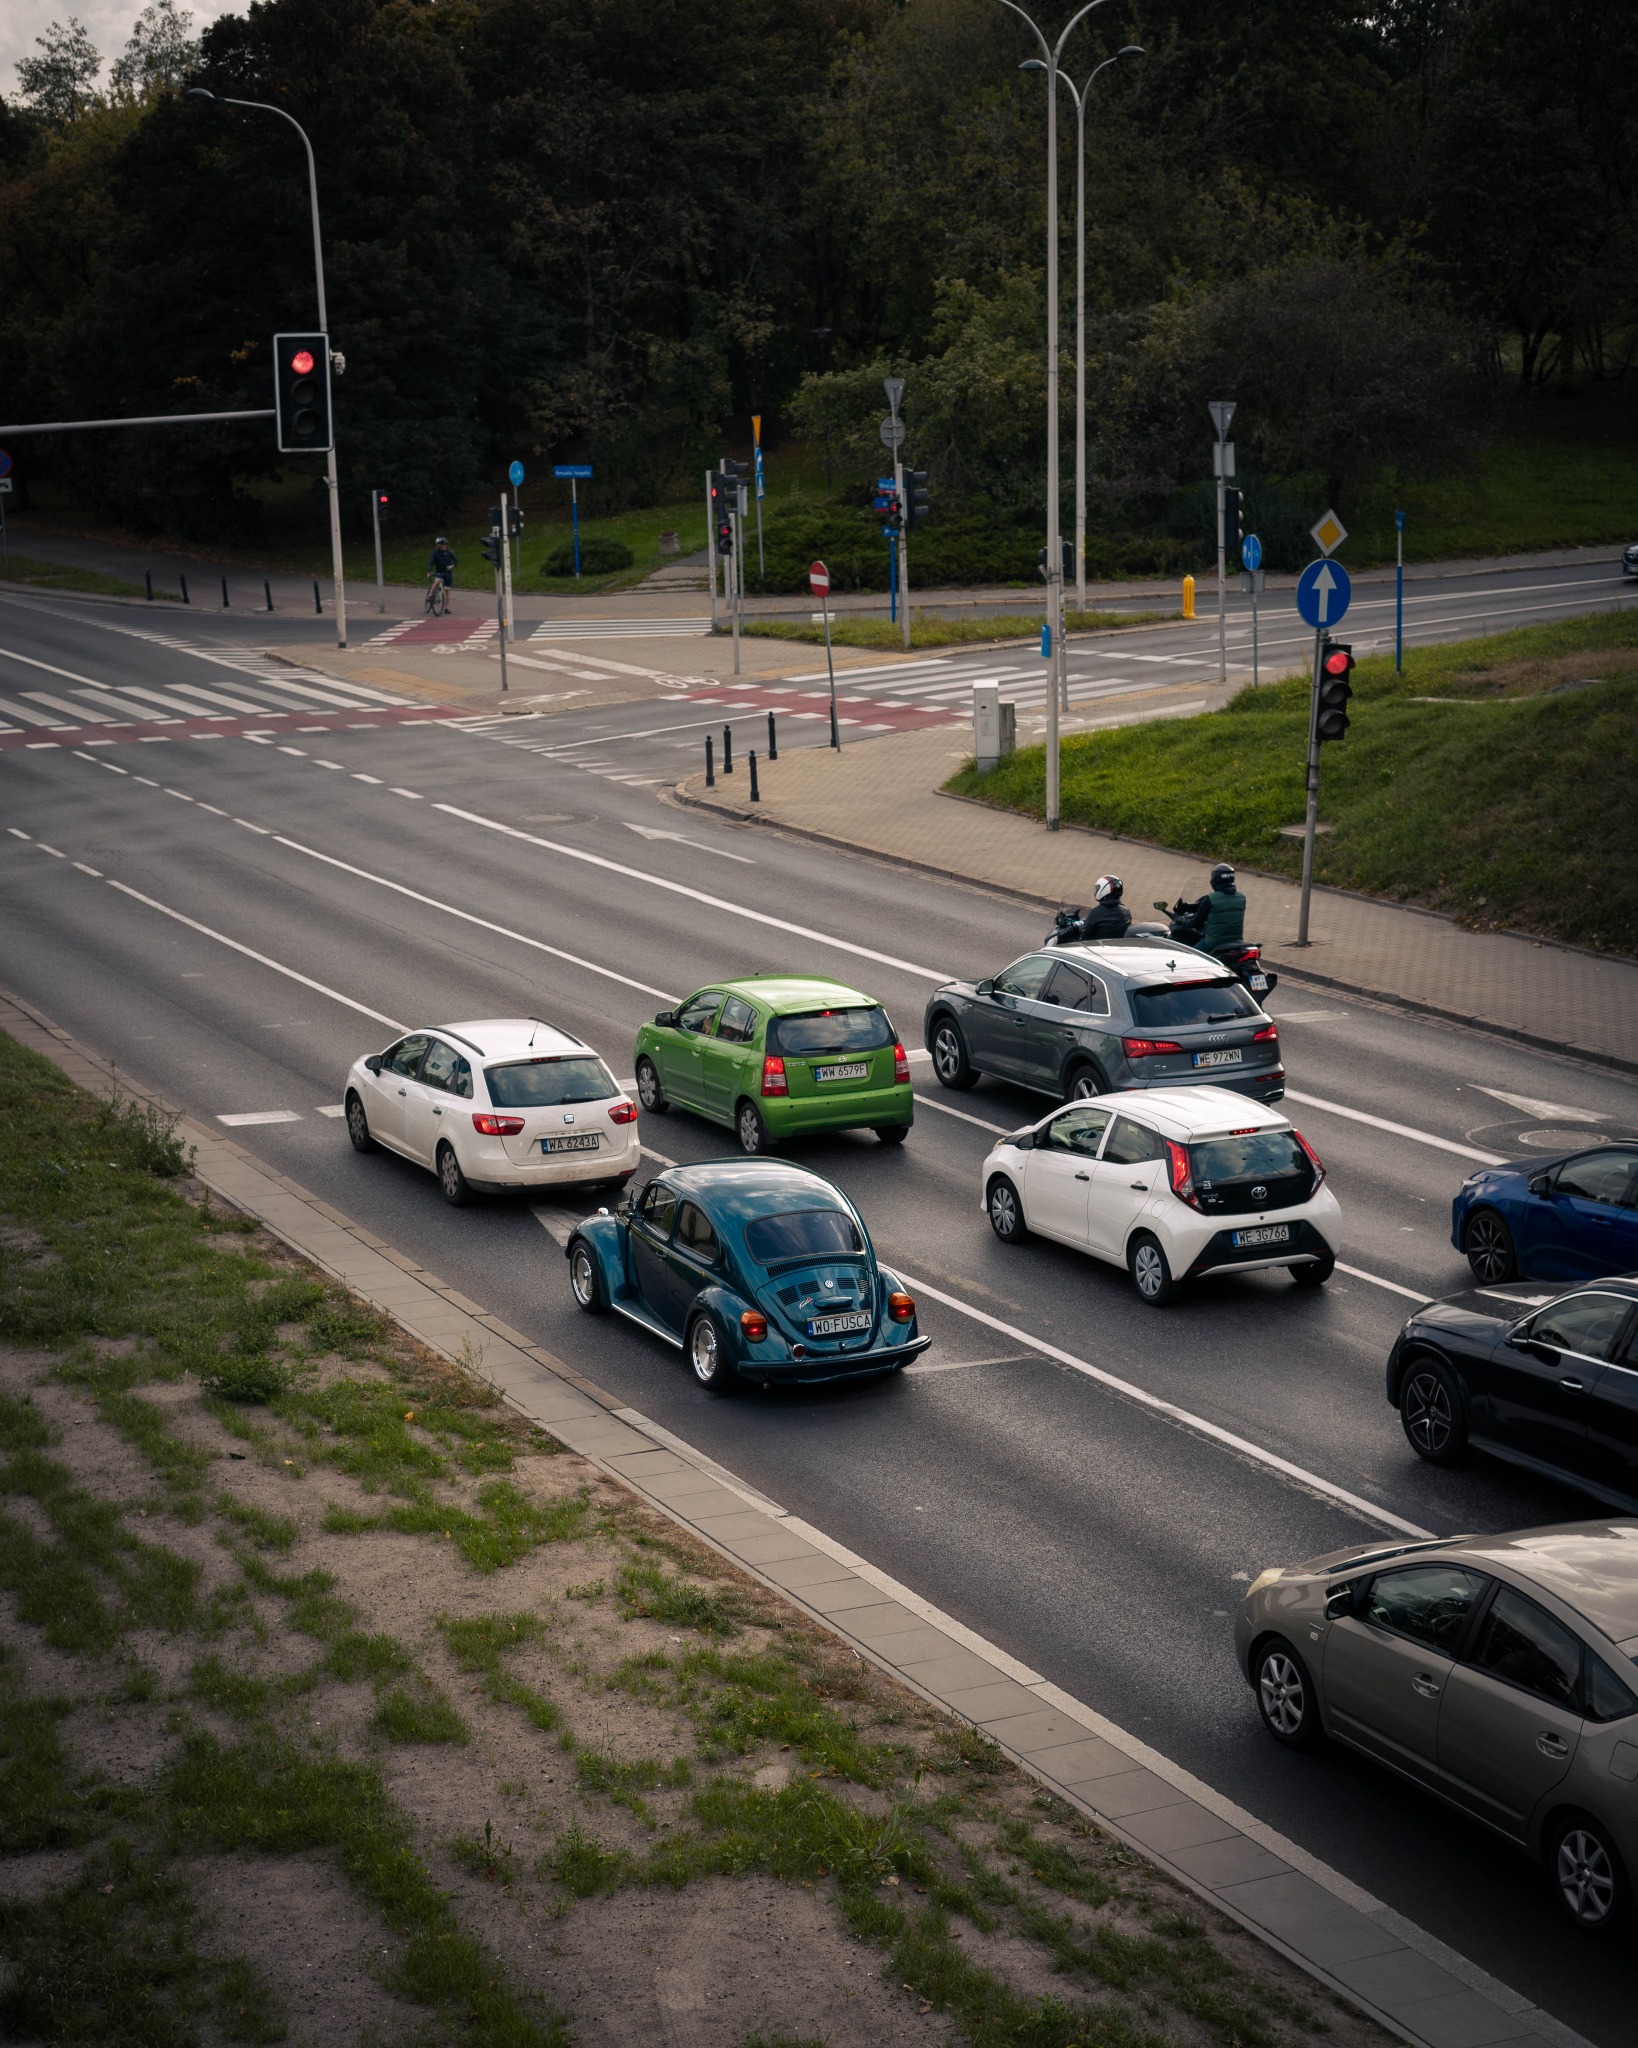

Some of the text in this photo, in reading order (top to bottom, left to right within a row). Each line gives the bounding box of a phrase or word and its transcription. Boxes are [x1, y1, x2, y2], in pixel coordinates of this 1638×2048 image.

[1198, 1051, 1240, 1064] WE 972WN
[821, 1064, 865, 1078] WW 6579F
[549, 1136, 597, 1151] WA 6243A
[1239, 1230, 1252, 1243] WE
[1256, 1226, 1287, 1241] 3G766
[834, 1314, 871, 1331] FUSCA
